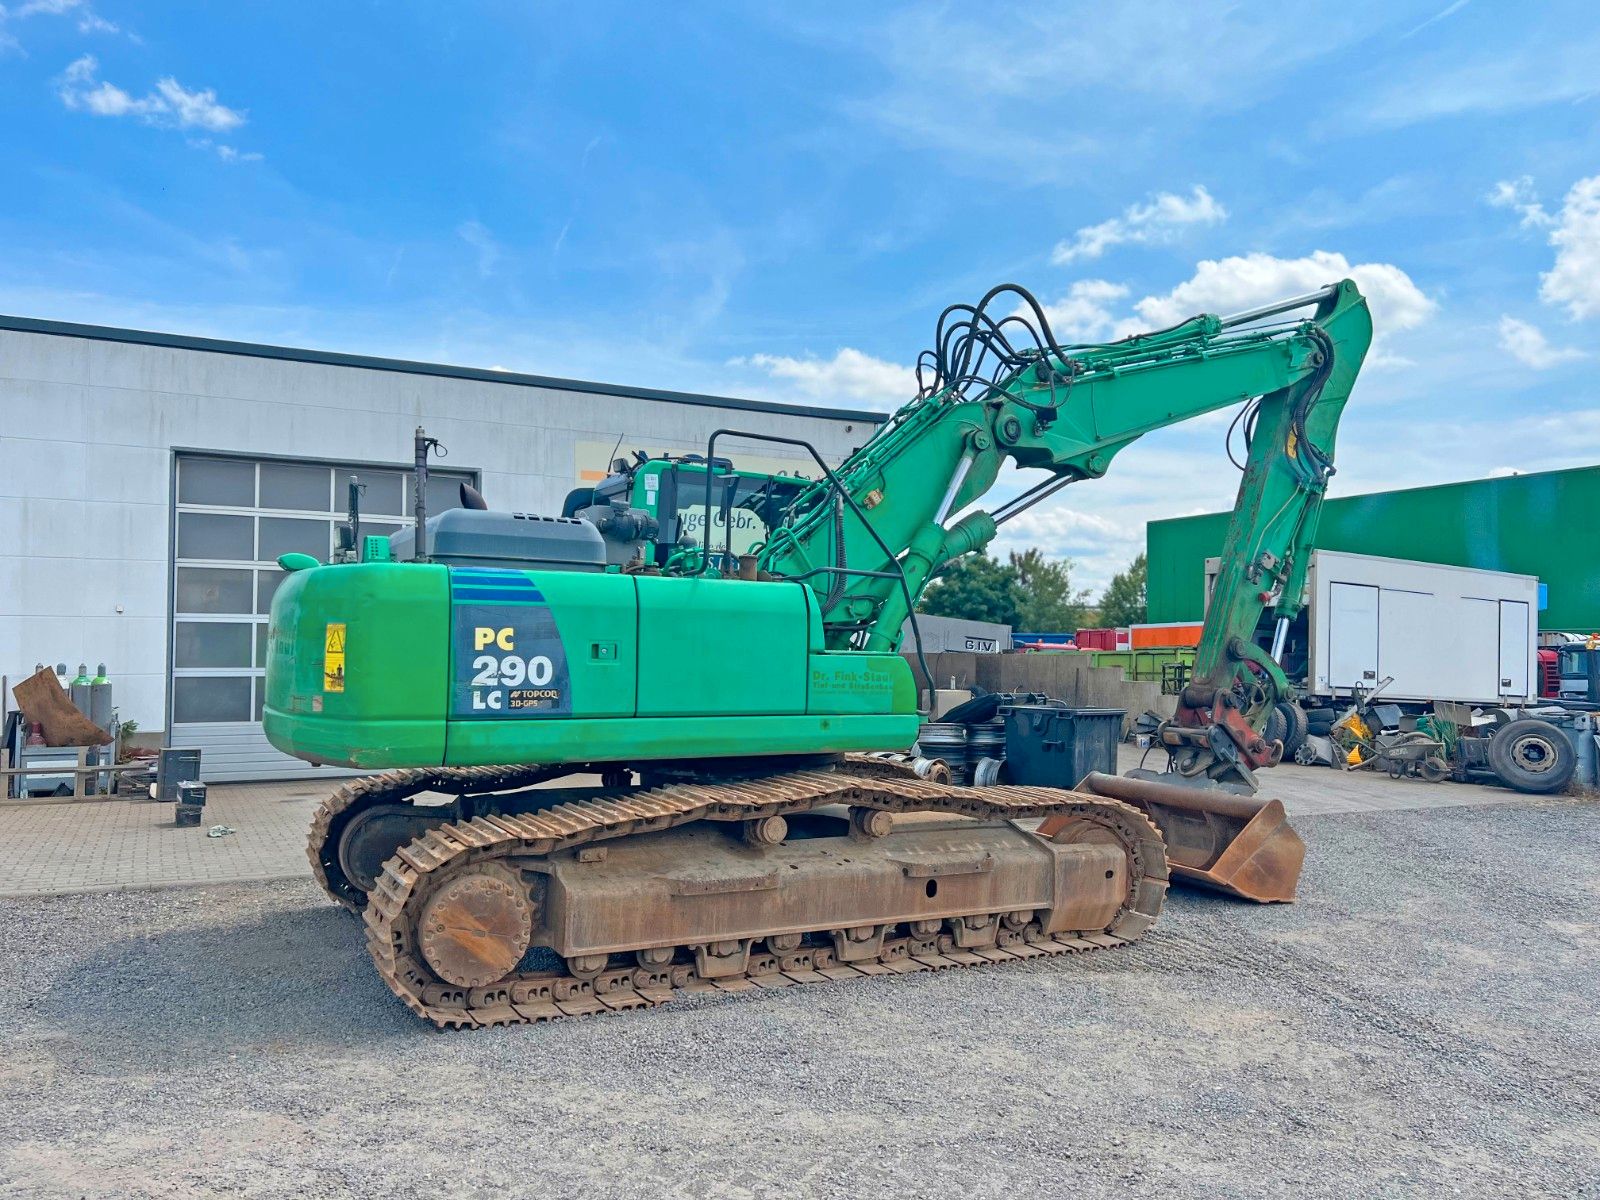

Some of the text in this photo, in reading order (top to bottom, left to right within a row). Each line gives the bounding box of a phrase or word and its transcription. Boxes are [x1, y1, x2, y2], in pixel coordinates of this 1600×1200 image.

[474, 627, 514, 651] PC
[471, 655, 553, 687] 290
[472, 690, 502, 709] LC
